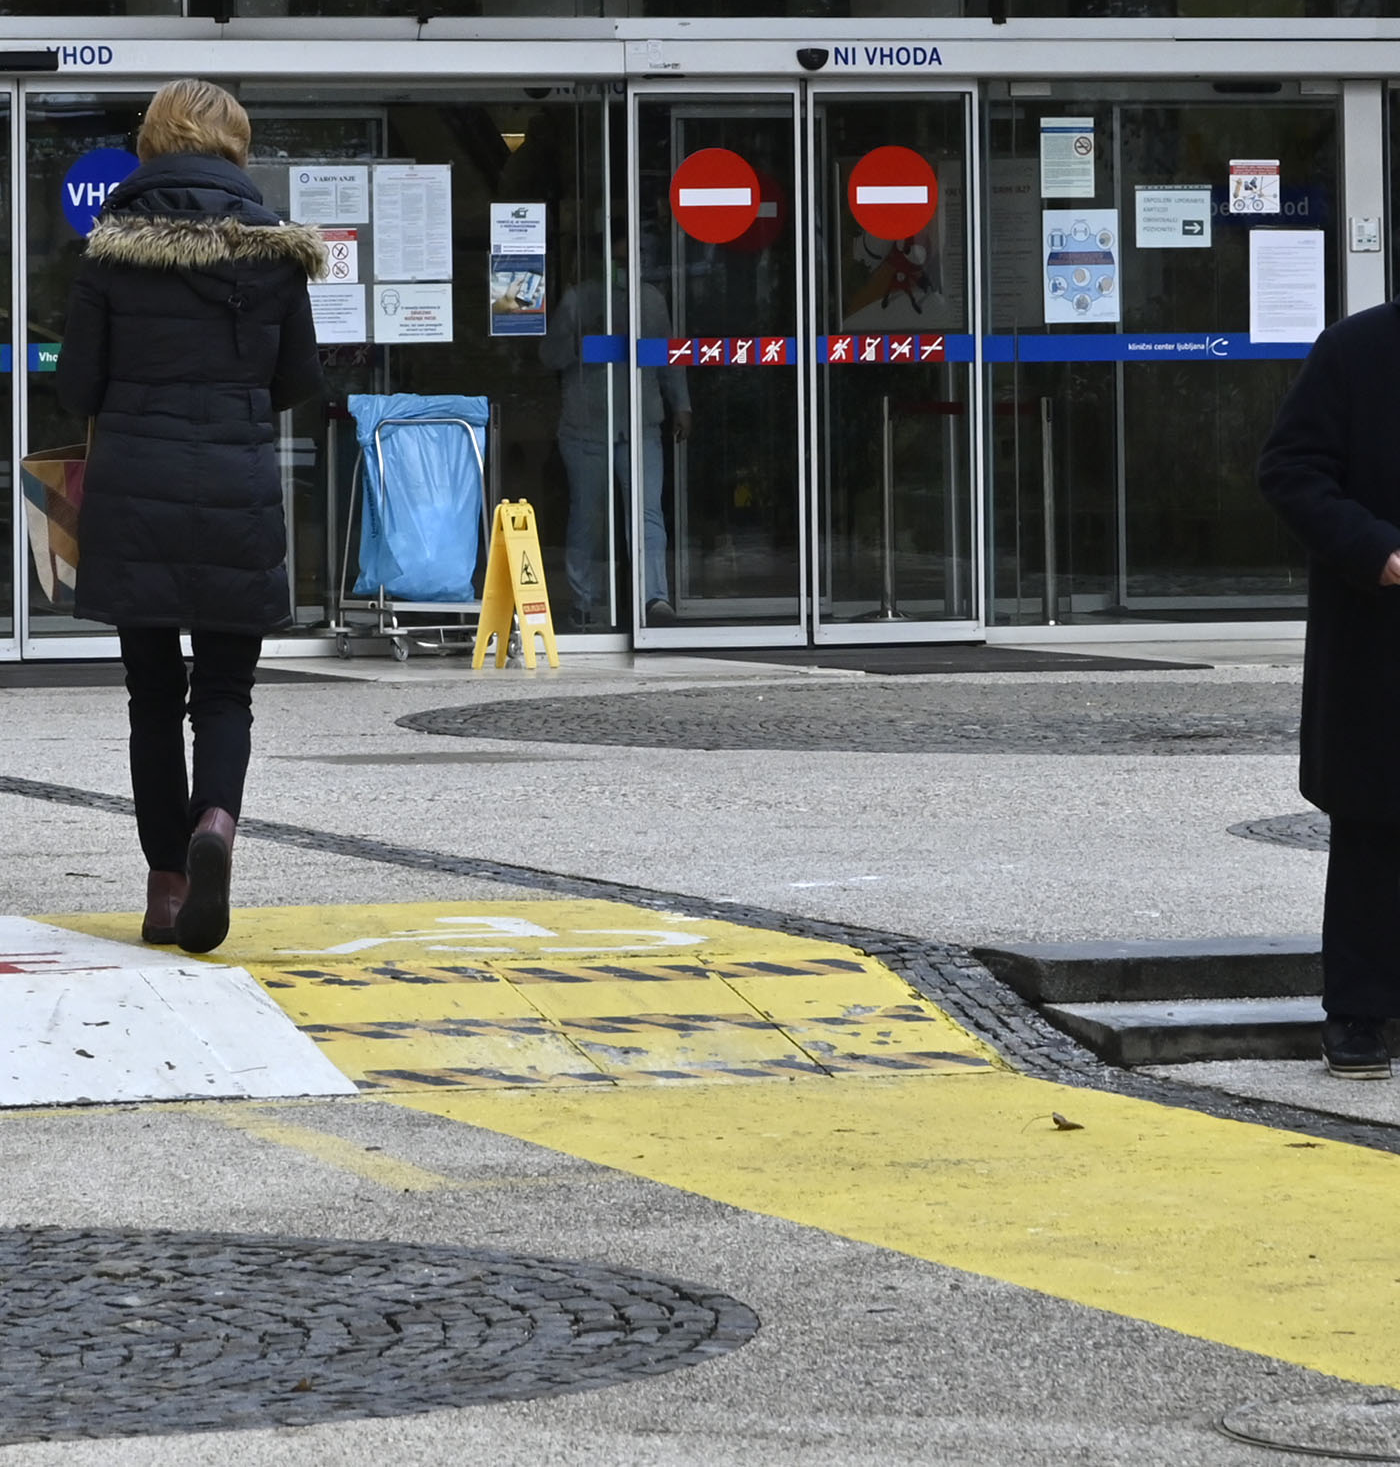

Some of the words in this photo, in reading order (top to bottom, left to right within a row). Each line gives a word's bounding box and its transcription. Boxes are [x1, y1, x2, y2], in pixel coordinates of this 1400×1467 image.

[46, 46, 113, 65] HOD
[833, 47, 856, 66] NI
[864, 47, 943, 66] VHODA
[1128, 341, 1152, 351] klinični
[1154, 342, 1175, 351] center
[1177, 341, 1205, 352] ljubljana
[39, 351, 58, 362] Vho
